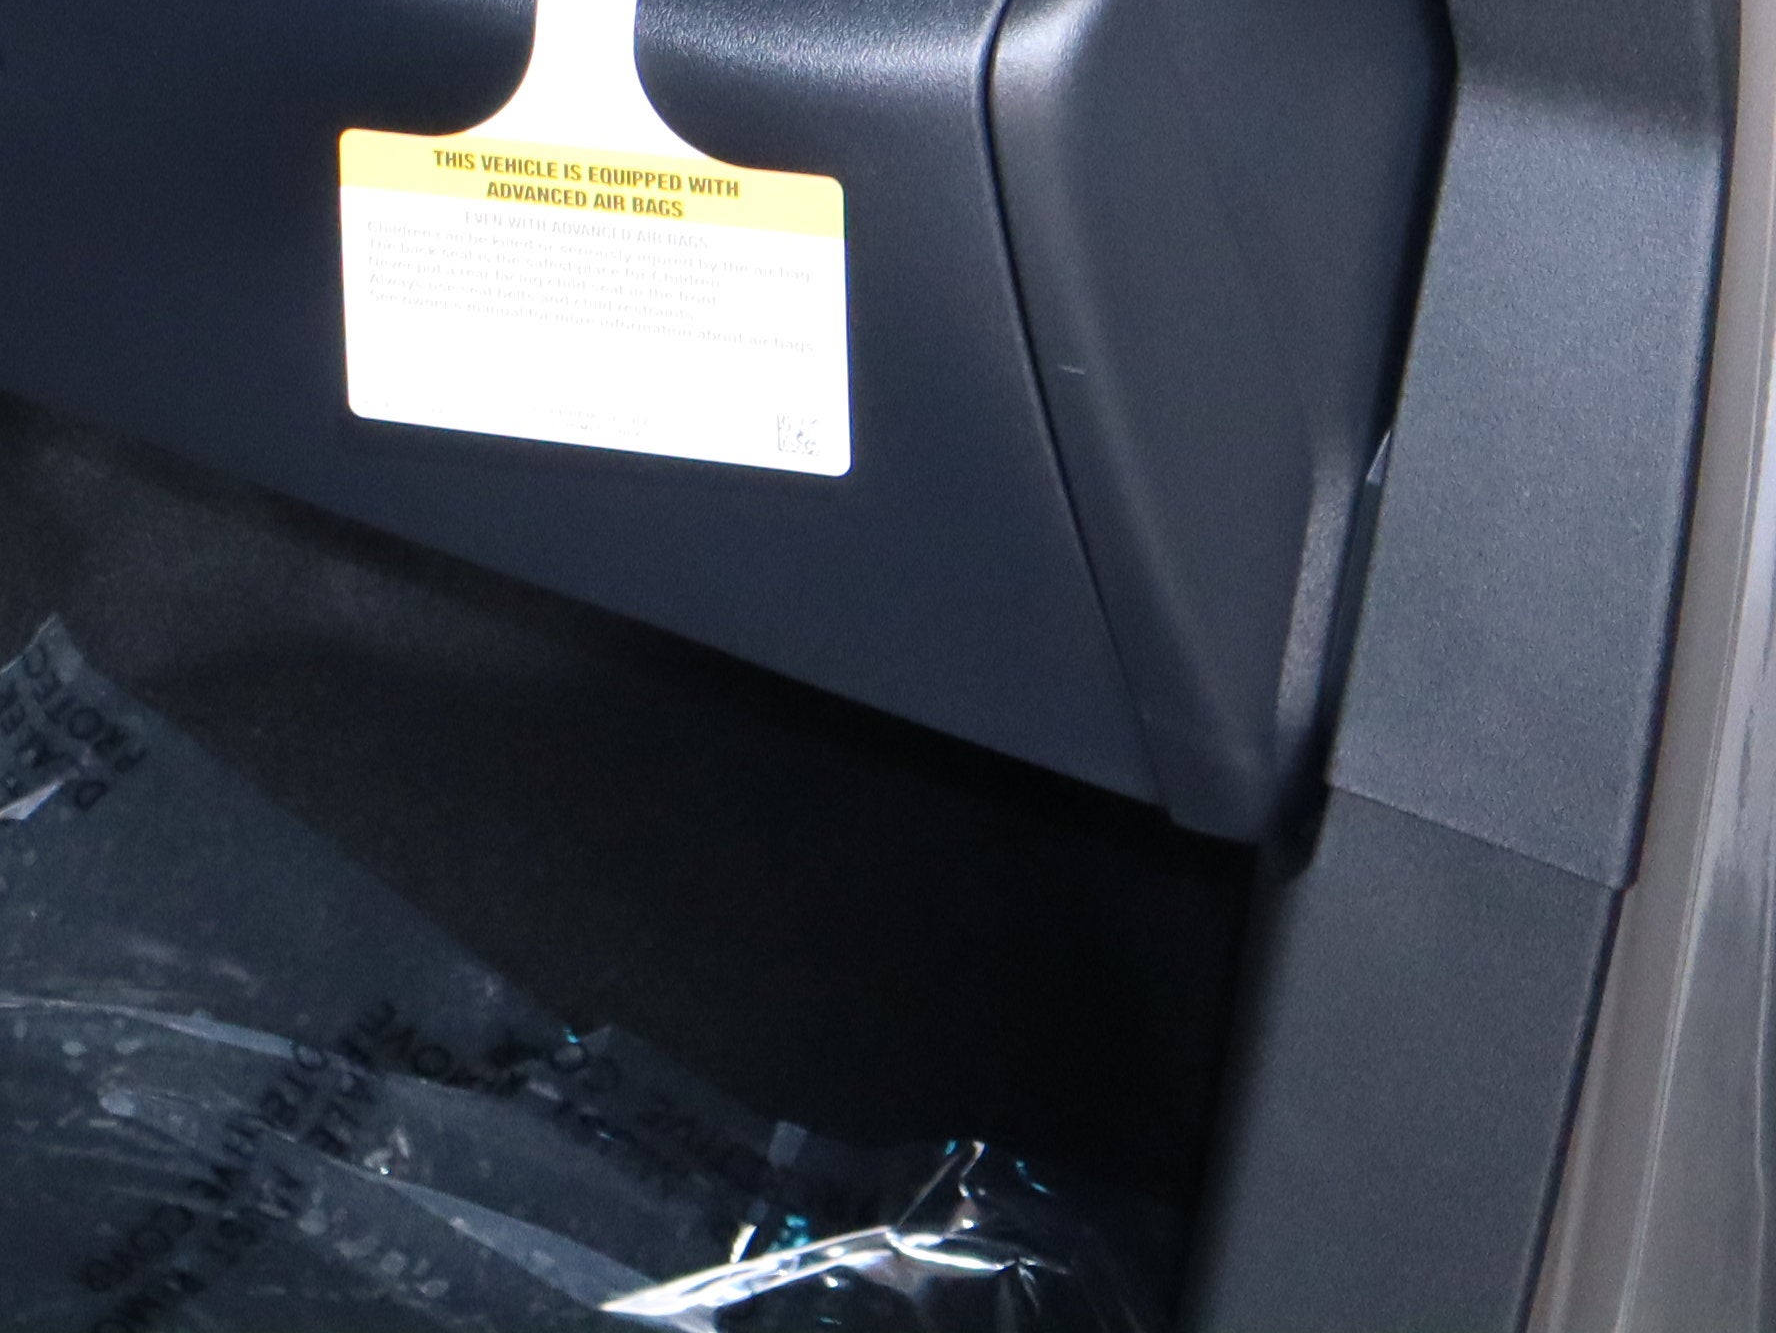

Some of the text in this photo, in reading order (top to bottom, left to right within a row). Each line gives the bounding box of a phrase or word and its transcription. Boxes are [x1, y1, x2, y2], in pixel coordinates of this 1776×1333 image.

[433, 150, 740, 198] THIS VEHICLE IS EQUIPPED WITH
[486, 181, 684, 217] ADVANCED AIR BAGS
